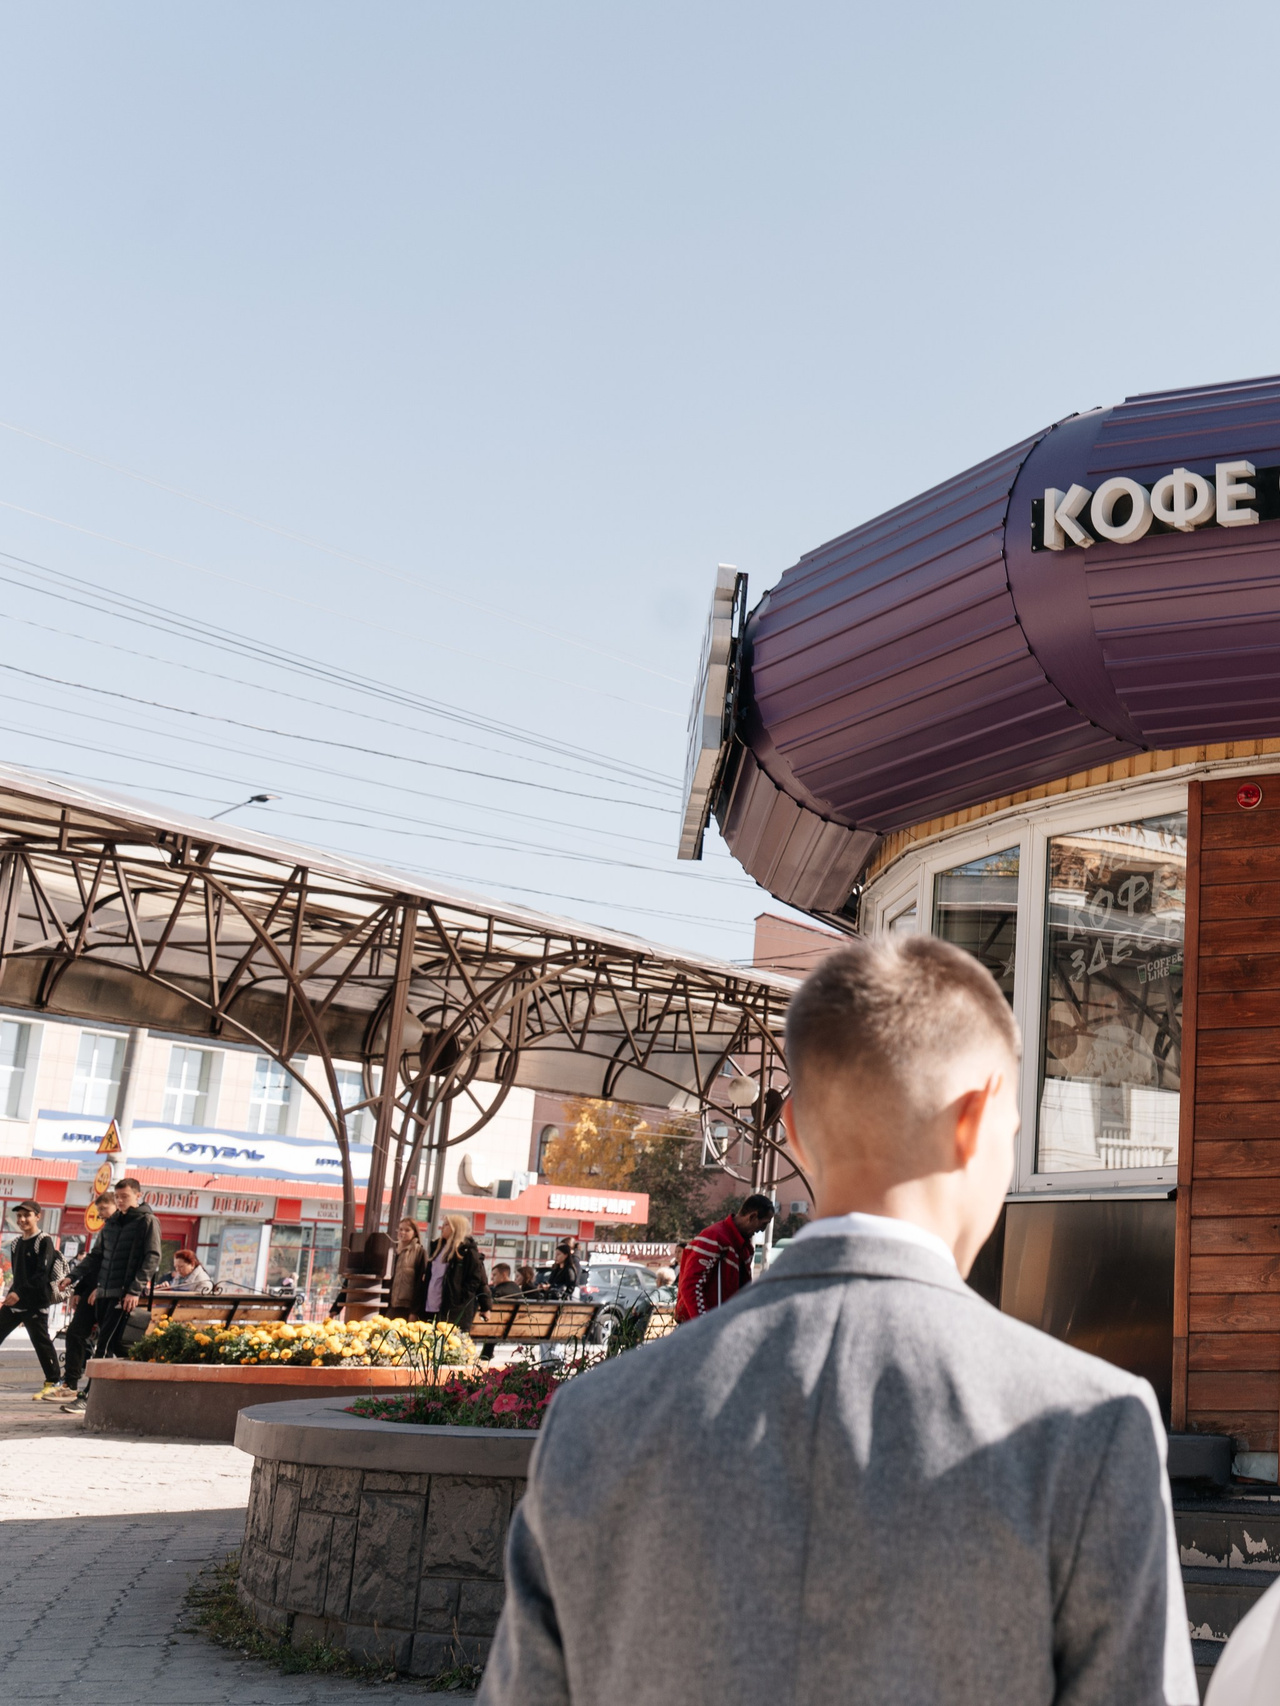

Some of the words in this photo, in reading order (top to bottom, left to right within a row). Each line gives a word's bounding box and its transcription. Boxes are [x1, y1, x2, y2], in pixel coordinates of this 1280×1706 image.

[1042, 459, 1260, 551] КОФЕ
[1069, 914, 1182, 983] ЗДЕСЬ
[1147, 951, 1183, 972] COFFEE
[1148, 966, 1170, 981] LIKE
[97, 1171, 109, 1186] 40
[212, 1195, 266, 1214] ЦЕНТР
[548, 1193, 636, 1215] УНИВЕРМАГ
